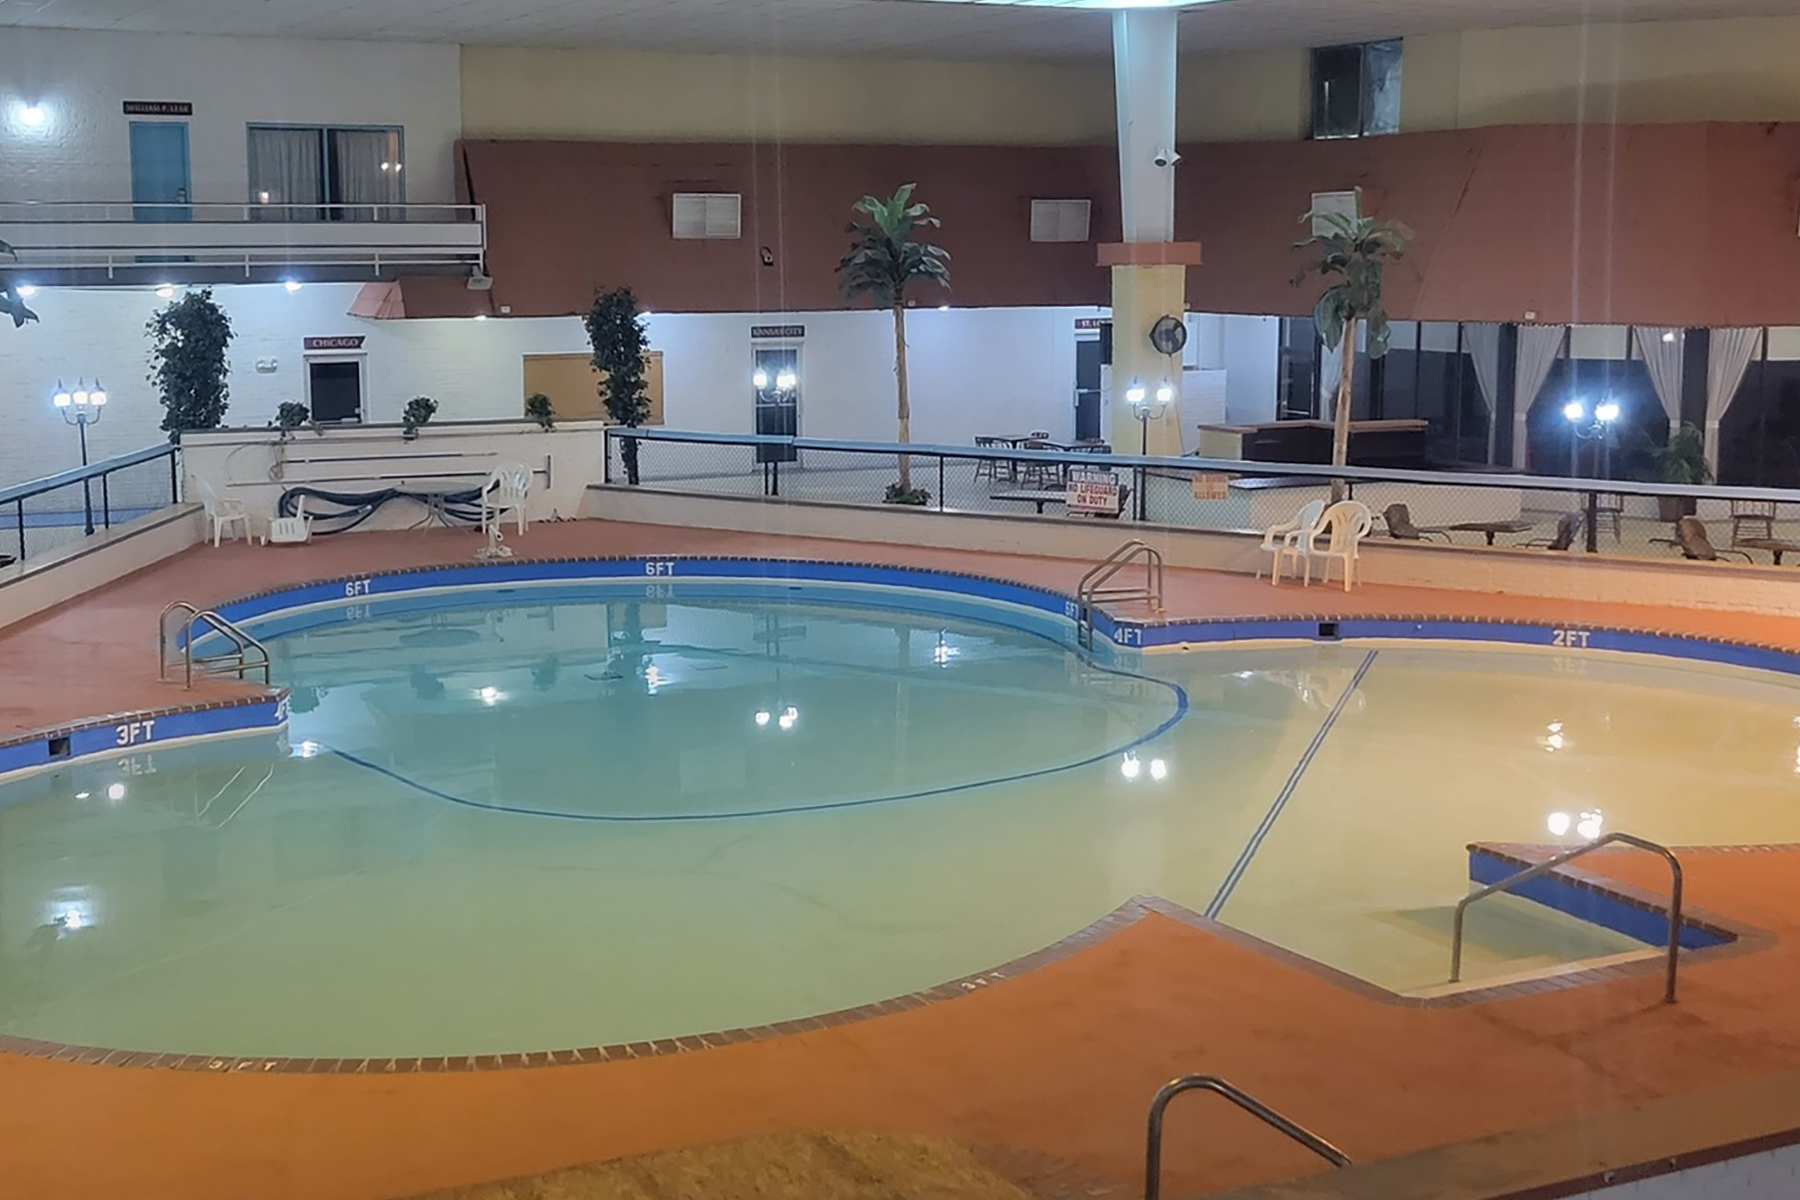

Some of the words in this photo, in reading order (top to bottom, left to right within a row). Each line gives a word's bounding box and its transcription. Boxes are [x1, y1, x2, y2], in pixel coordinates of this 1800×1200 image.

[753, 328, 784, 336] KANSAS
[784, 327, 802, 336] CITY
[312, 338, 359, 348] CHICAGO
[1071, 470, 1116, 485] WARNING
[1068, 482, 1078, 493] NO
[1080, 484, 1118, 497] LIFEGUARD
[1077, 493, 1087, 504] ON
[1089, 495, 1108, 506] DUTY
[645, 561, 675, 576] 6FT
[345, 579, 371, 597] 6FT
[1114, 627, 1142, 645] 4FT
[1552, 629, 1591, 648] 2FT
[116, 720, 155, 745] 3FT
